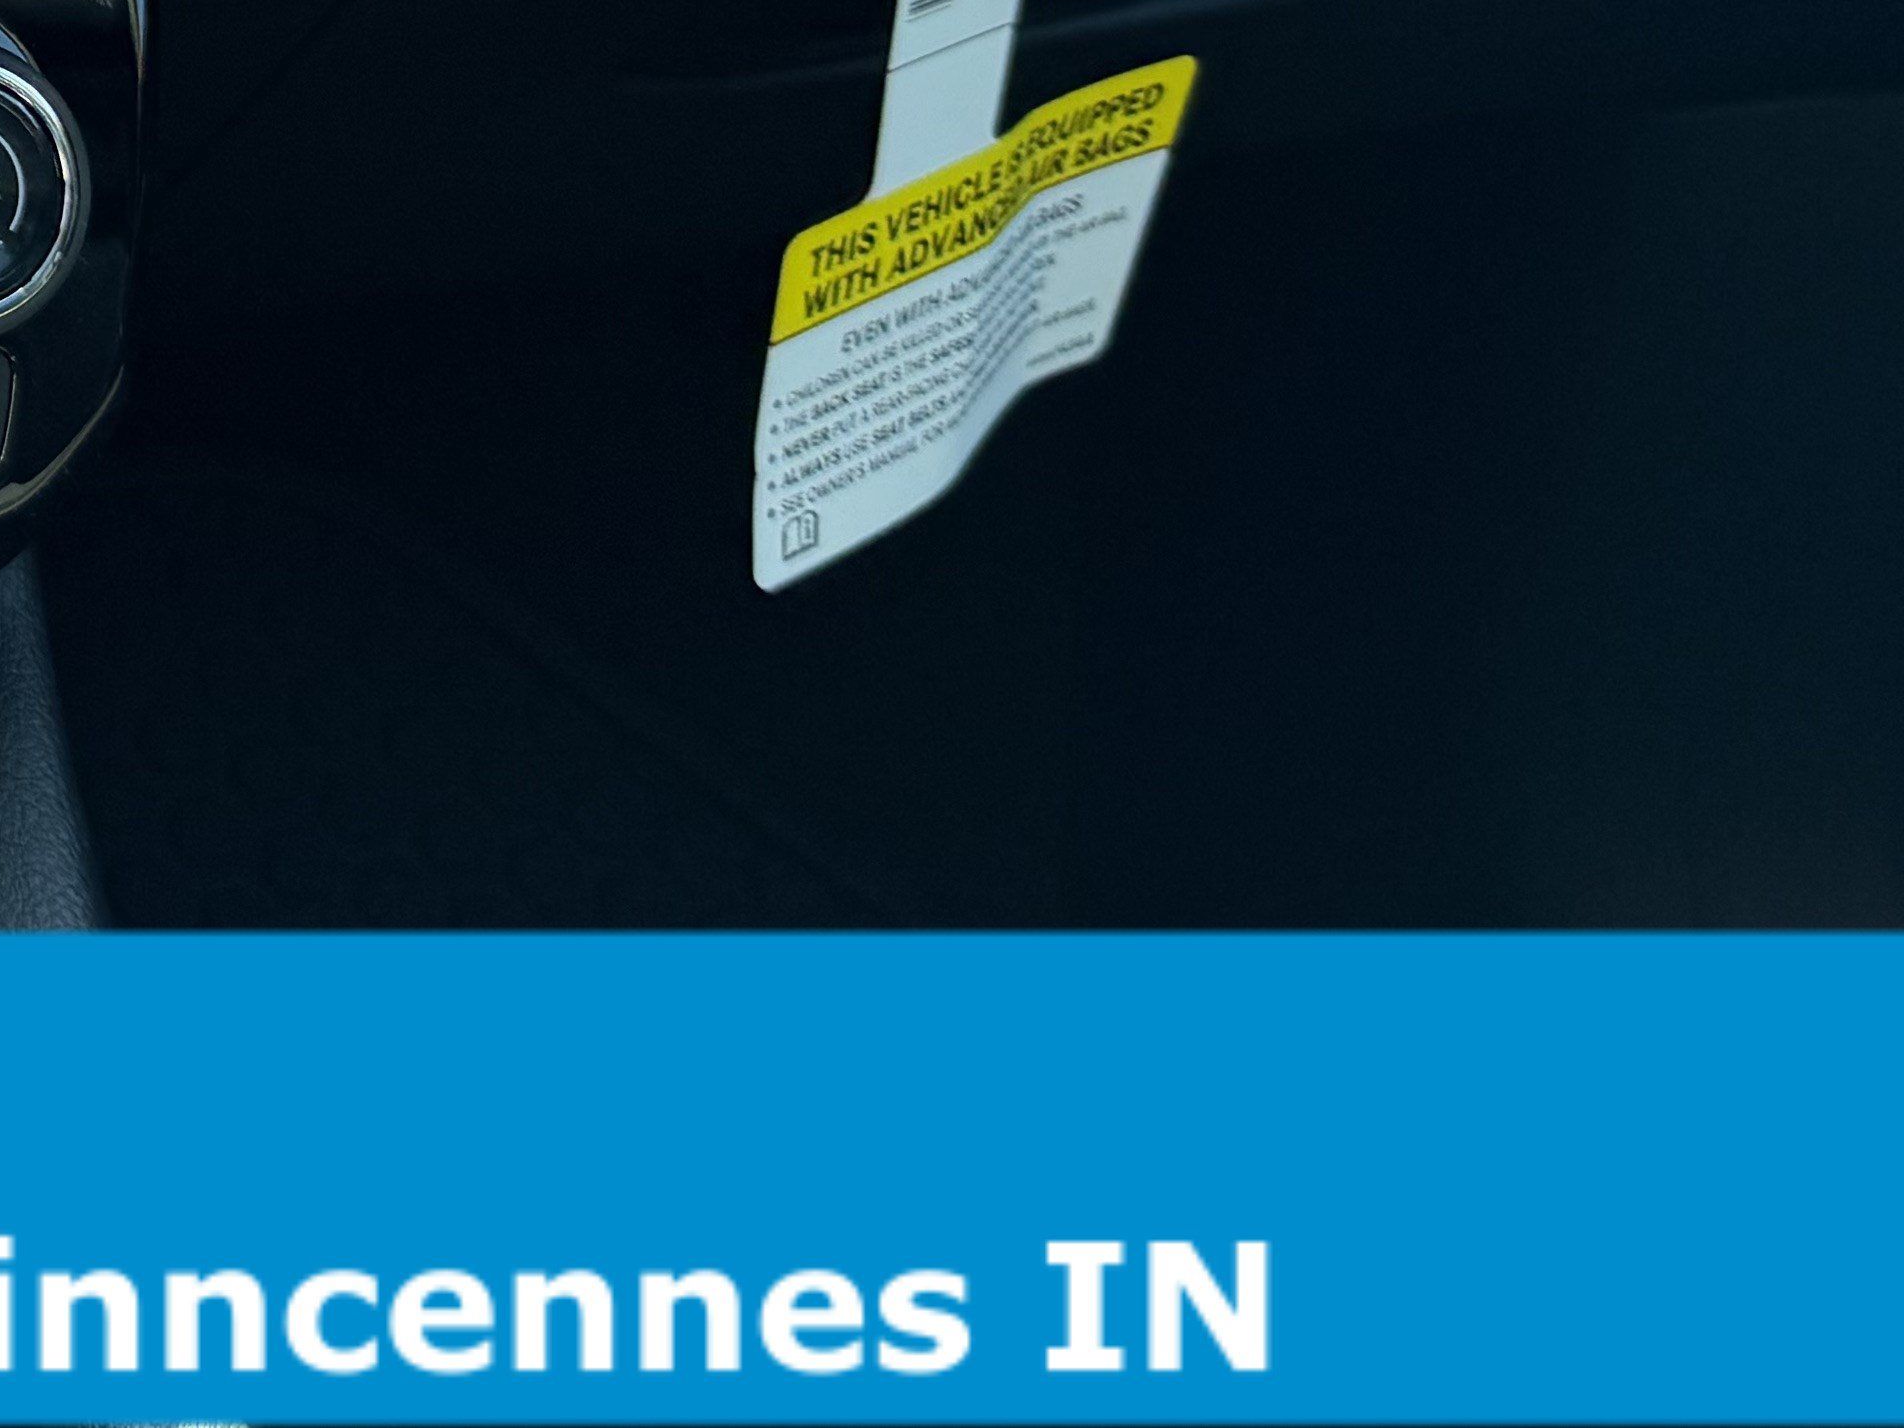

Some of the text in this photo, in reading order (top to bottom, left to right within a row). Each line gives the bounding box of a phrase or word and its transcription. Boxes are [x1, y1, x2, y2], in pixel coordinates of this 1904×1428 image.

[810, 221, 877, 278] THIS
[885, 158, 1004, 238] VEHICLE
[802, 257, 881, 319] WITH
